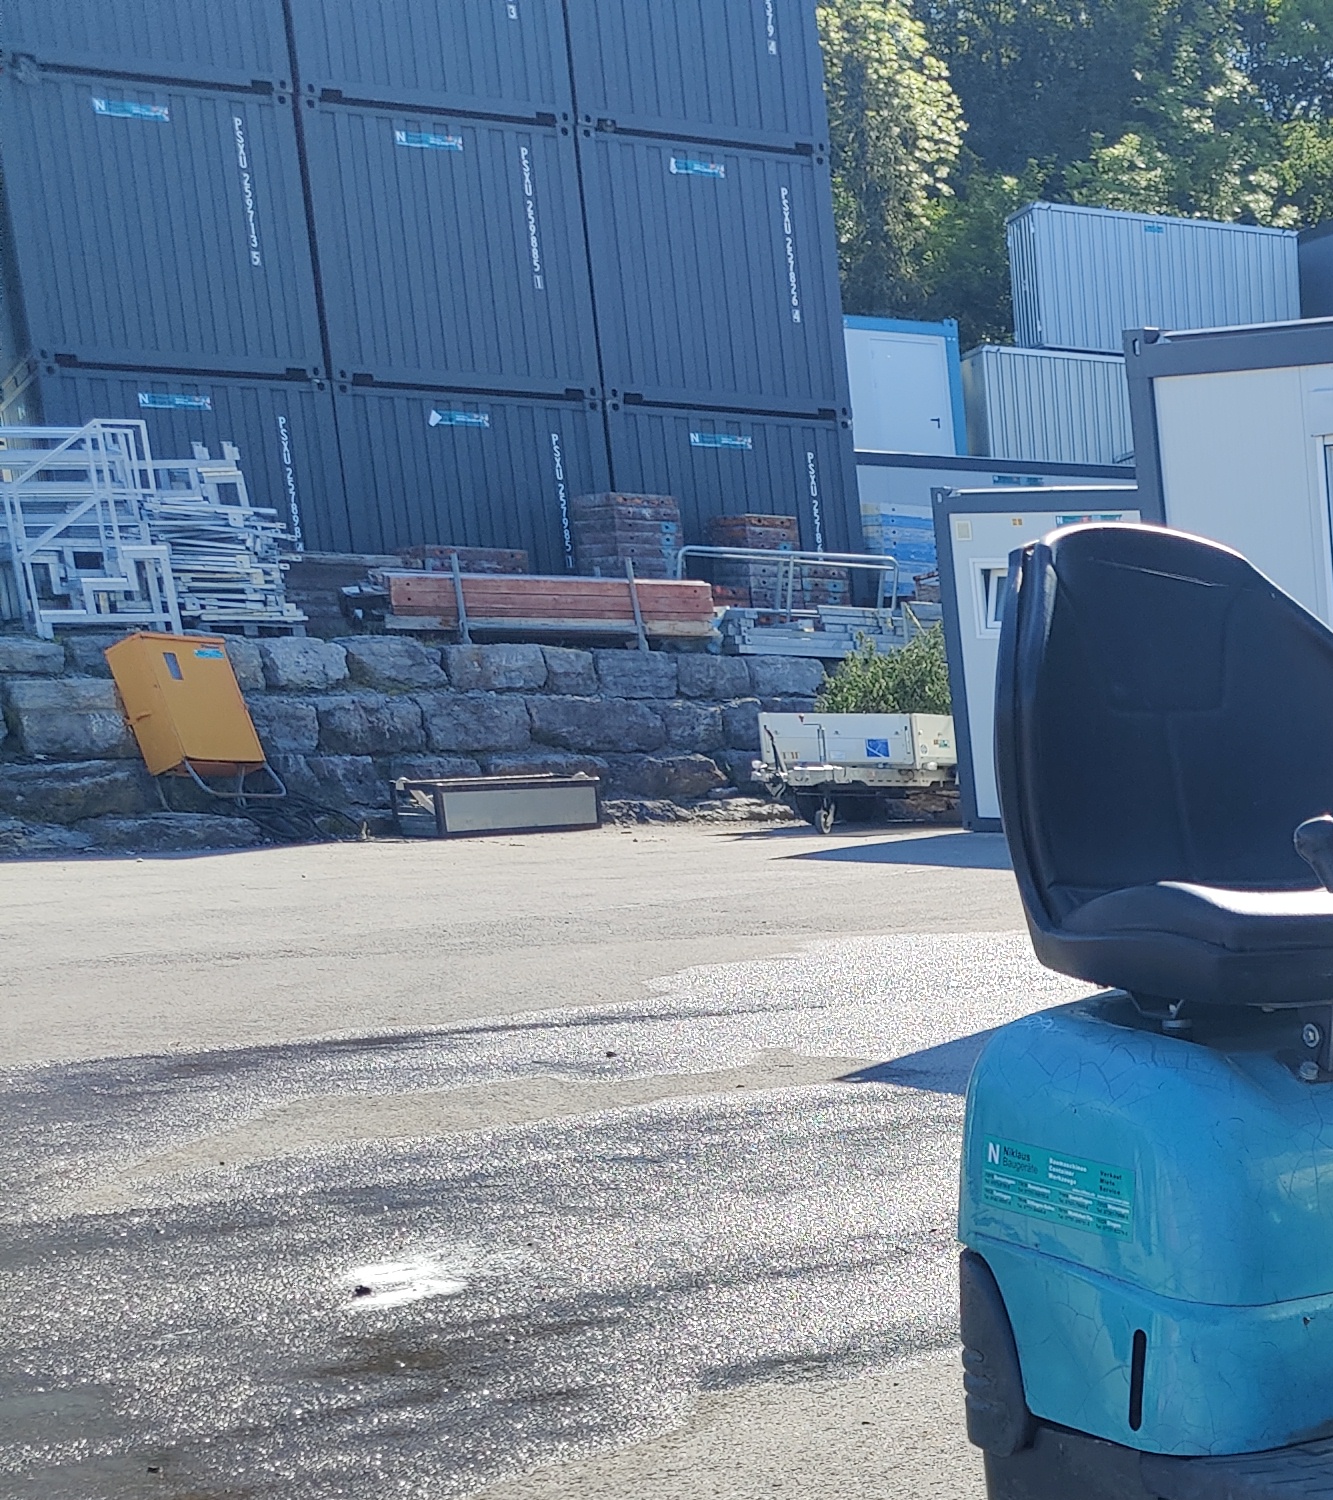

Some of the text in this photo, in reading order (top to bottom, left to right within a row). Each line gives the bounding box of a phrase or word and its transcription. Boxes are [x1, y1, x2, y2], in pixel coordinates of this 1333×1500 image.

[233, 117, 261, 266] PSXU 259713 5
[520, 147, 532, 196] PSXU
[526, 200, 540, 272] 259885
[780, 187, 791, 234] PSXU
[786, 237, 798, 306] 257826
[139, 393, 149, 404] N
[690, 432, 700, 443] N
[278, 416, 291, 464] PSXU
[286, 468, 301, 539] 257898
[551, 433, 563, 480] PSXU
[558, 484, 571, 552] 257985
[807, 452, 818, 496] PSXU
[987, 1142, 1000, 1165] N
[1003, 1146, 1030, 1162] Niklaus
